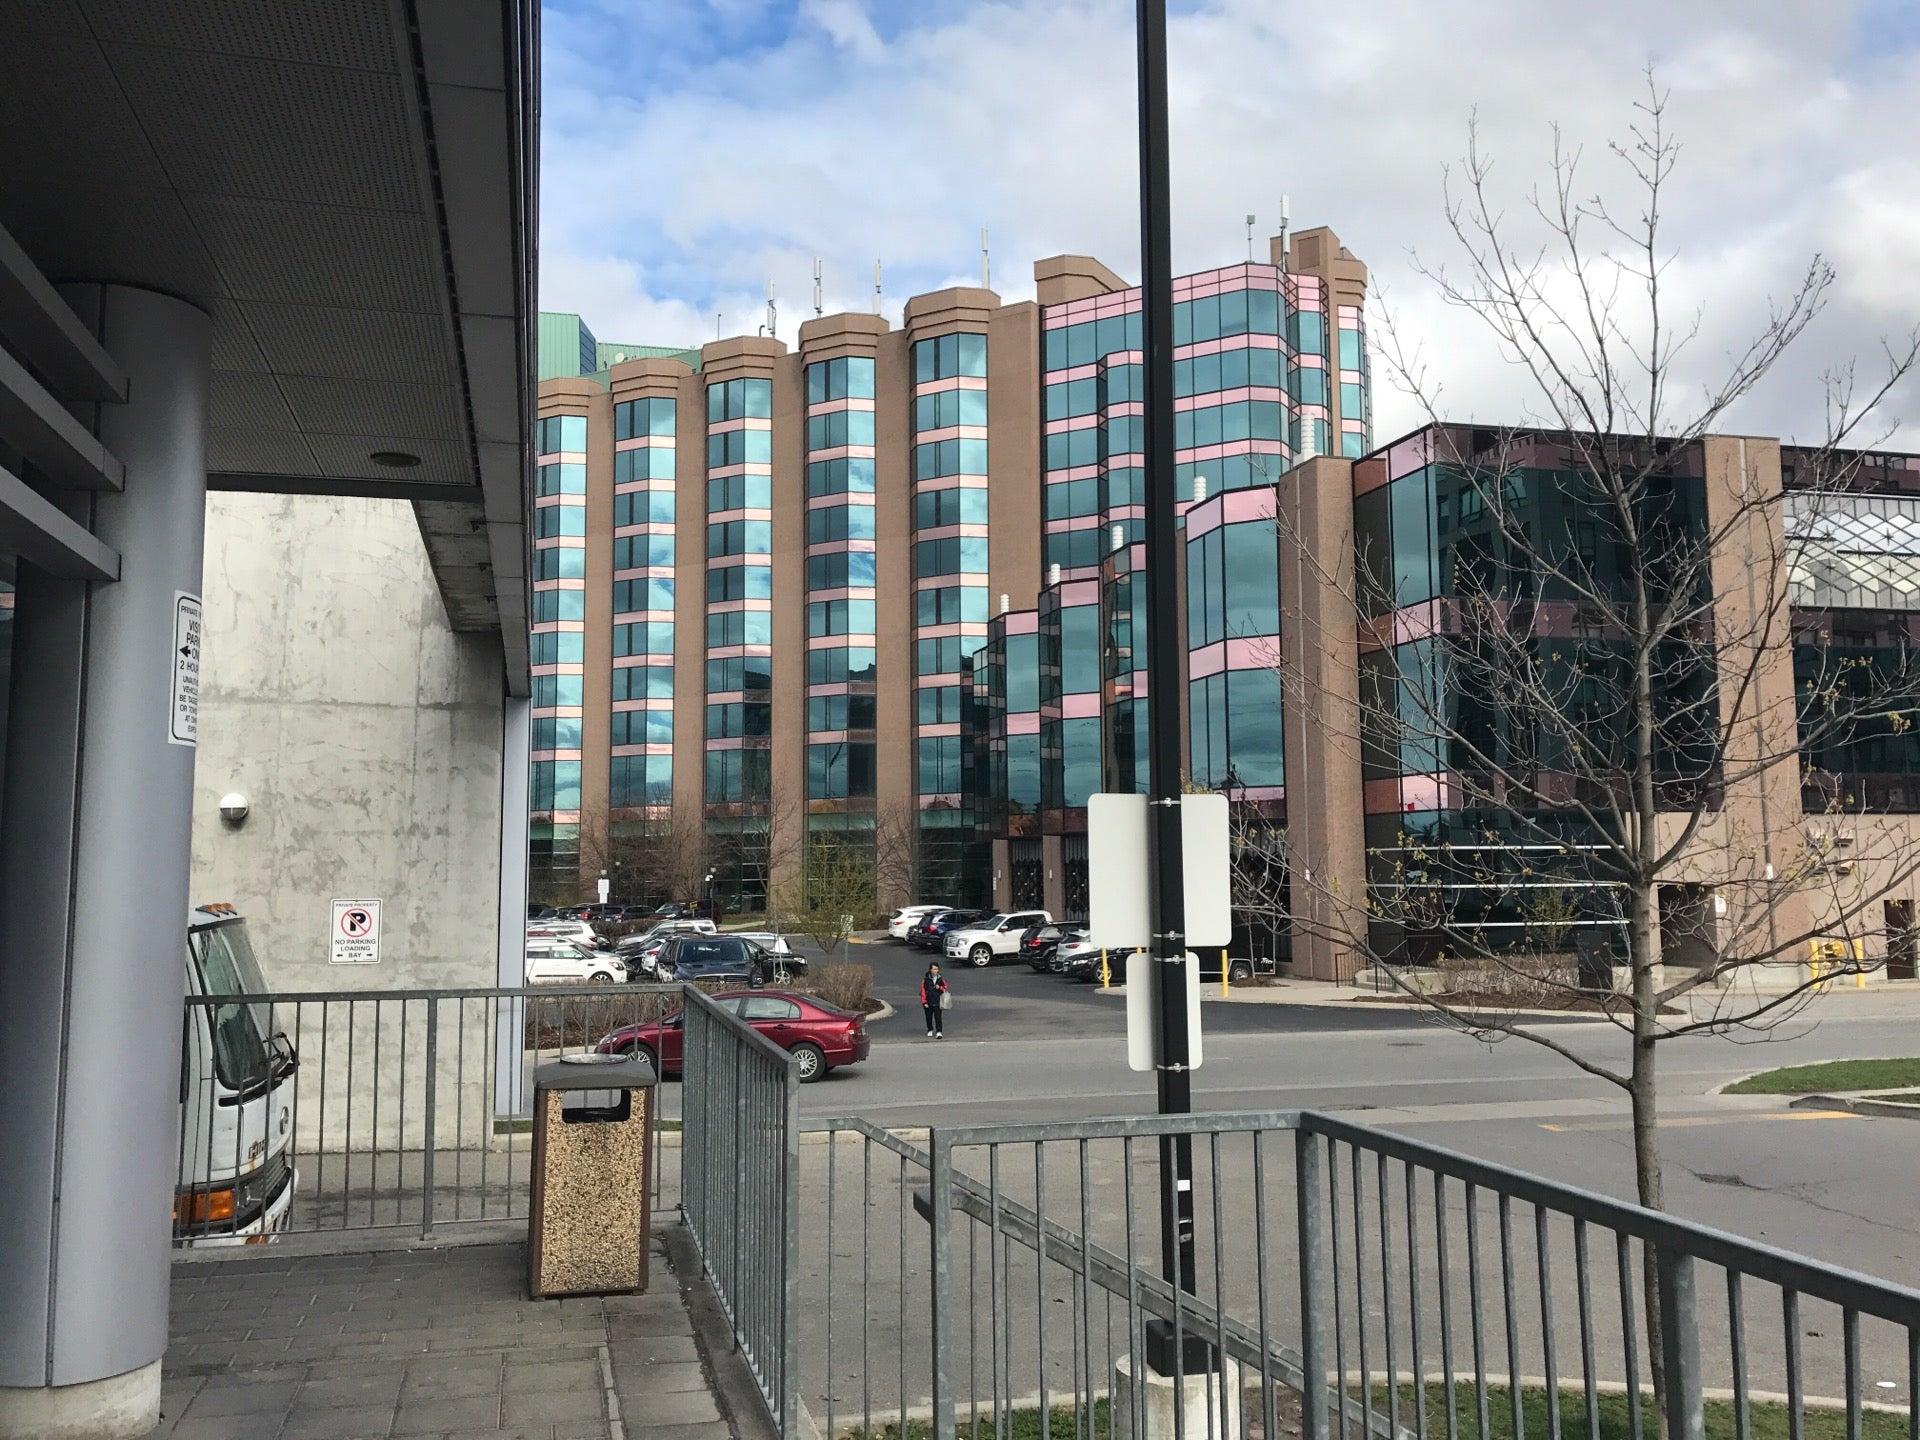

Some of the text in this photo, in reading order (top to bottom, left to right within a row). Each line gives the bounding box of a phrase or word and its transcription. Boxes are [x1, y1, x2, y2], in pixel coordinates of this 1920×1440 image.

[180, 660, 185, 670] 2
[179, 694, 187, 703] BE
[179, 704, 188, 712] OR
